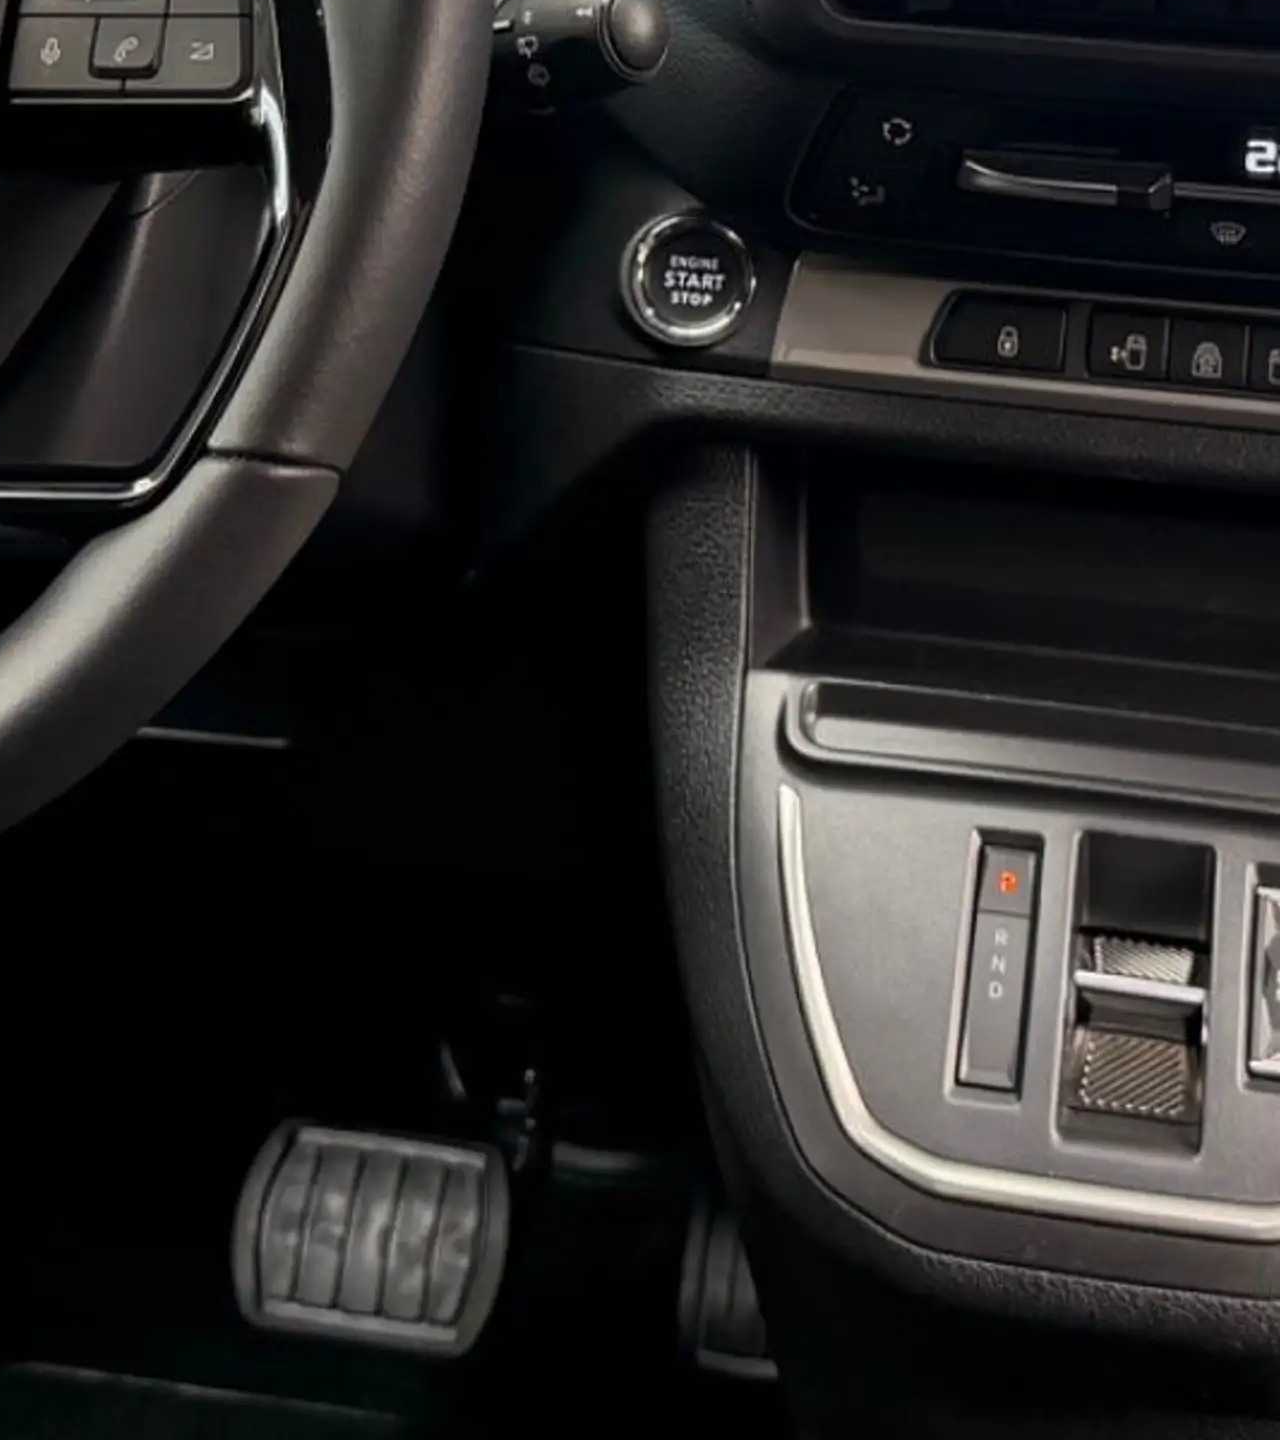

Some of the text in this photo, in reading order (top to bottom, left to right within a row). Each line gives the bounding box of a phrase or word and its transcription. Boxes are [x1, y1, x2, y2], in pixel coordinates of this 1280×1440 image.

[669, 254, 720, 271] ENGINE
[663, 270, 726, 291] START
[670, 291, 713, 306] STOP
[998, 870, 1017, 893] P
[993, 927, 1009, 947] R
[990, 953, 1006, 976] N
[987, 980, 1004, 999] D
